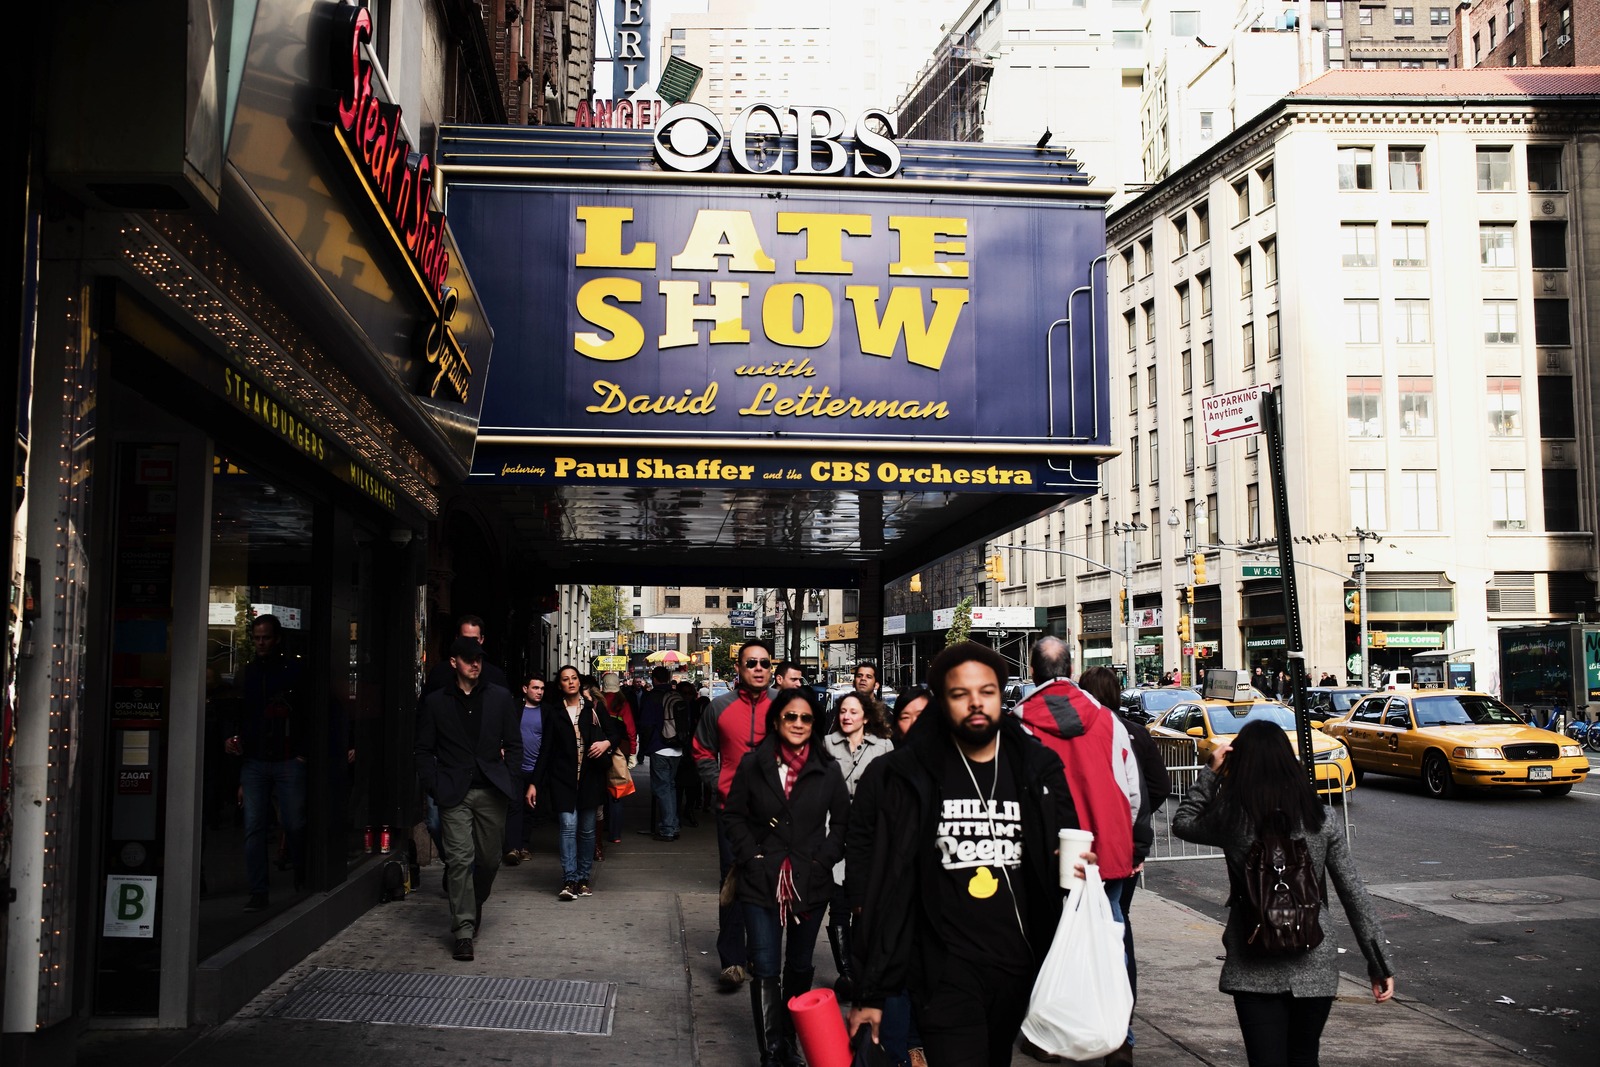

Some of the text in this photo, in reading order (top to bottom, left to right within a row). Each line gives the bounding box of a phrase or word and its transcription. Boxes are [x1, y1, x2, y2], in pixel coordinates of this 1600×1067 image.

[574, 98, 682, 130] ANGEL
[338, 7, 402, 204] Steak
[405, 152, 450, 302] Shake
[729, 102, 902, 179] CBS
[575, 205, 970, 278] LATE
[573, 276, 970, 371] SHOW
[735, 357, 817, 377] with
[224, 366, 325, 461] STEAKBURGERS
[585, 380, 951, 420] David Letterman
[1206, 390, 1258, 410] NO PARKING
[1208, 406, 1243, 421] Anytime
[501, 457, 1033, 485] featuring Paul Shaffer and the CBS Orchestra
[350, 460, 396, 511] MILKSHAKES
[1247, 638, 1286, 647] STARBUCKS COFFEE
[1411, 636, 1440, 644] COFFEE
[114, 702, 161, 710] OPEN DAILY
[818, 692, 824, 702] P
[120, 772, 151, 780] ZAGAT
[120, 780, 139, 788] 2013
[940, 798, 1021, 822] HILLI
[935, 835, 1023, 868] Peeps
[117, 884, 145, 921] B
